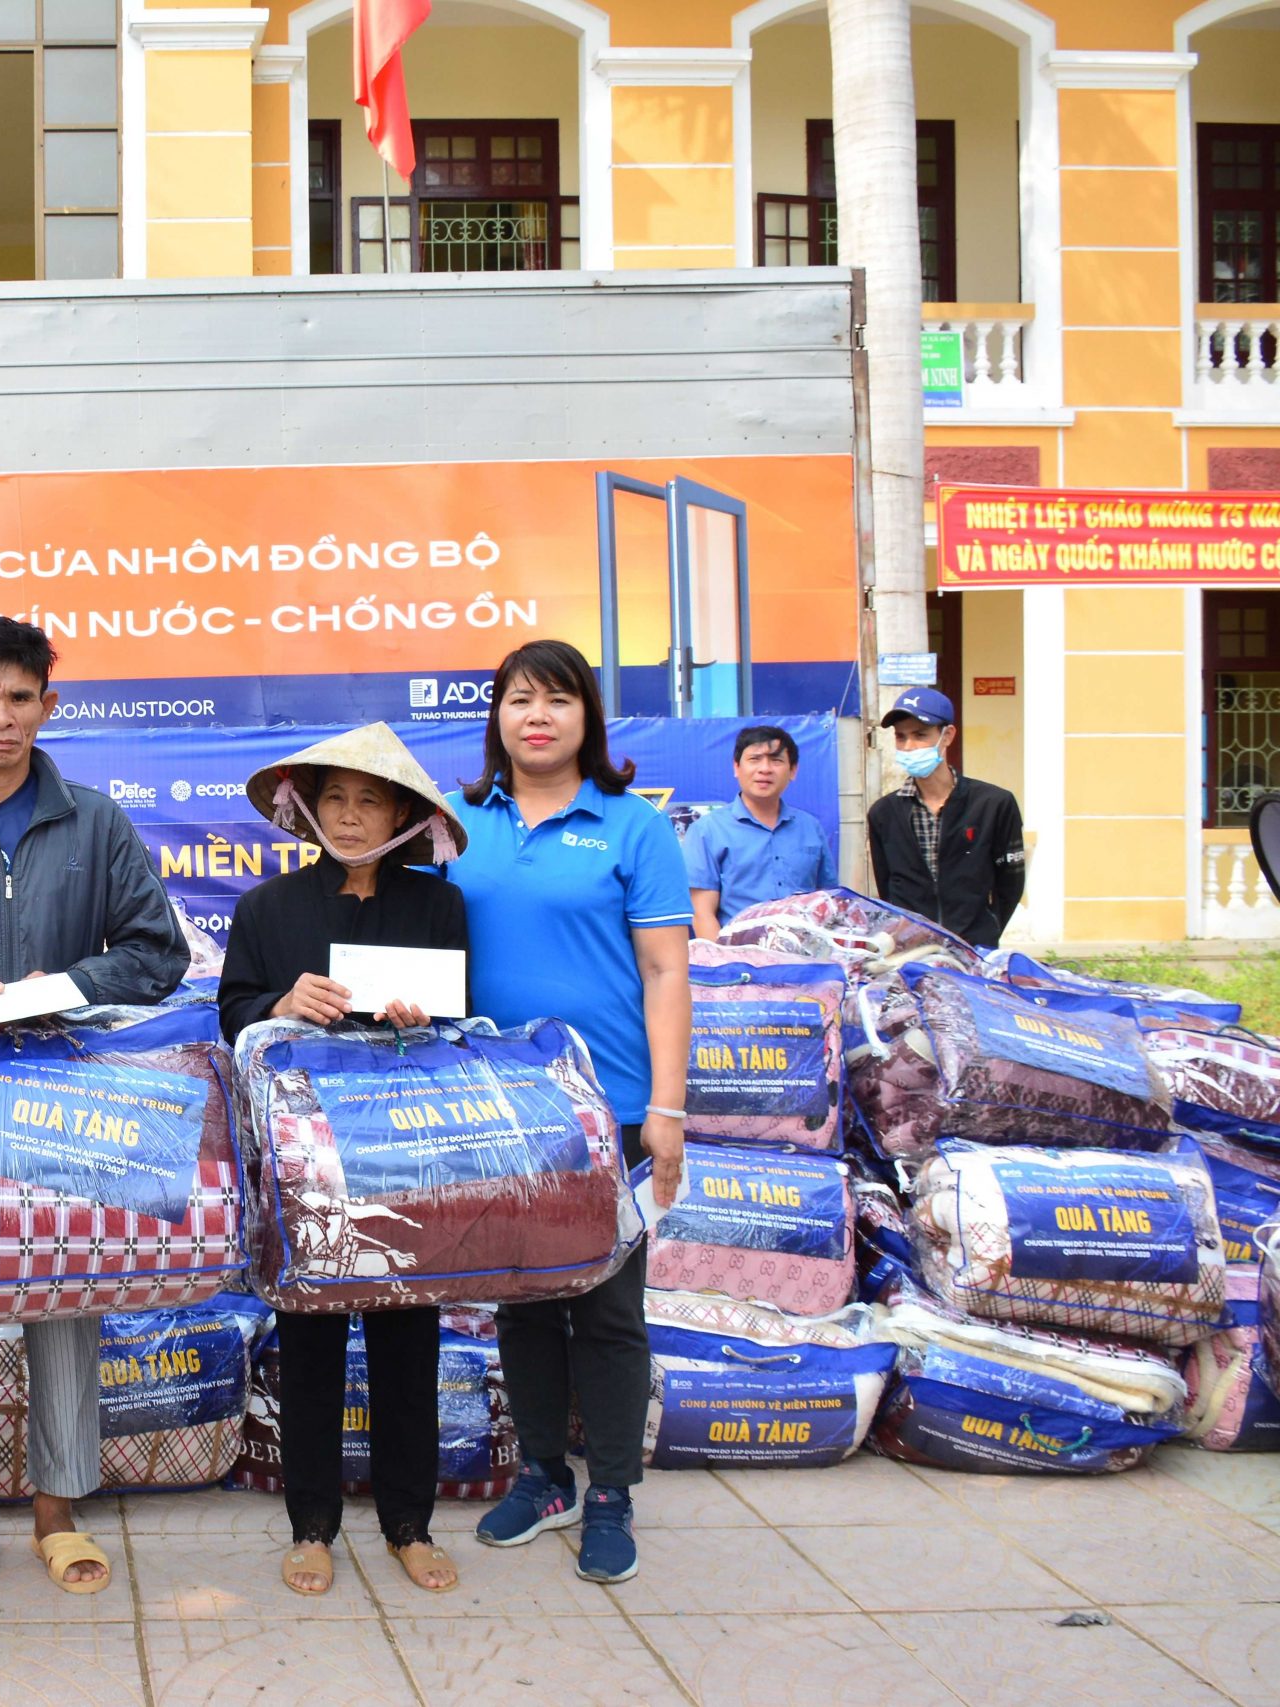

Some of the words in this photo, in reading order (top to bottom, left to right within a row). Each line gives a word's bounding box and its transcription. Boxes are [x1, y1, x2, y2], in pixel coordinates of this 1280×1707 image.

[966, 497, 1029, 535] NHIỆT
[1034, 497, 1079, 535] LIỆT
[1084, 498, 1143, 529] CHÀO
[1219, 502, 1247, 528] 75
[107, 538, 260, 576] NHÔM
[269, 533, 419, 572] ĐỒNG
[429, 531, 501, 571] BỘ
[956, 538, 987, 572] VÀ
[991, 537, 1050, 571] NGÀY
[1055, 534, 1114, 574] QUỐC
[1118, 537, 1192, 570] KHÁNH
[1197, 537, 1256, 570] NƯỚC
[88, 600, 235, 638] NƯỚC
[271, 594, 456, 633] CHỐNG
[465, 591, 537, 628] ỒN
[442, 680, 494, 704] ADG
[49, 701, 106, 720] ĐOÀN
[109, 699, 215, 719] AUSTDOOR
[423, 711, 441, 720] HÀO
[477, 710, 490, 719] HIỆ
[195, 783, 247, 799] ecopa
[160, 832, 262, 878] MIỀN
[577, 837, 608, 851] ADG
[782, 1027, 811, 1036] TRUNG
[696, 1043, 735, 1070] QUÀ
[738, 1043, 788, 1073] TẶNG
[16, 1079, 41, 1089] ADG
[44, 1081, 86, 1096] HƯỚNG
[90, 1089, 106, 1100] VỀ
[108, 1094, 138, 1106] MIỀN
[142, 1098, 183, 1115] TRUNG
[339, 1093, 371, 1103] CÙNG
[375, 1091, 399, 1100] ADG
[13, 1099, 63, 1132] QUÀ
[73, 1108, 140, 1147] TẶNG
[388, 1102, 446, 1131] QUÀ
[443, 1099, 517, 1126] TẶNG
[0, 1129, 25, 1142] TRÌNH
[25, 1136, 39, 1145] DO
[83, 1147, 128, 1166] AUSTDOOR
[418, 1138, 431, 1146] DO
[95, 1161, 126, 1176] 11/2020
[703, 1176, 744, 1201] QUÀ
[747, 1181, 800, 1208] TẶNG
[1055, 1203, 1098, 1232] QUÀ
[1098, 1205, 1152, 1237] TẶNG
[99, 1338, 112, 1347] DG
[189, 1321, 222, 1334] TRUNG
[100, 1355, 142, 1387] QUÀ
[145, 1348, 201, 1383] TẶNG
[176, 1392, 200, 1403] 11/2020
[680, 1399, 707, 1409] CÙNG
[709, 1400, 729, 1409] ADG
[732, 1398, 765, 1409] HƯỚNG
[768, 1399, 782, 1410] VỀ
[784, 1398, 807, 1410] MIỀN
[808, 1399, 842, 1409] TRUNG
[709, 1418, 751, 1443] QUÀ
[757, 1420, 812, 1446] TẶNG
